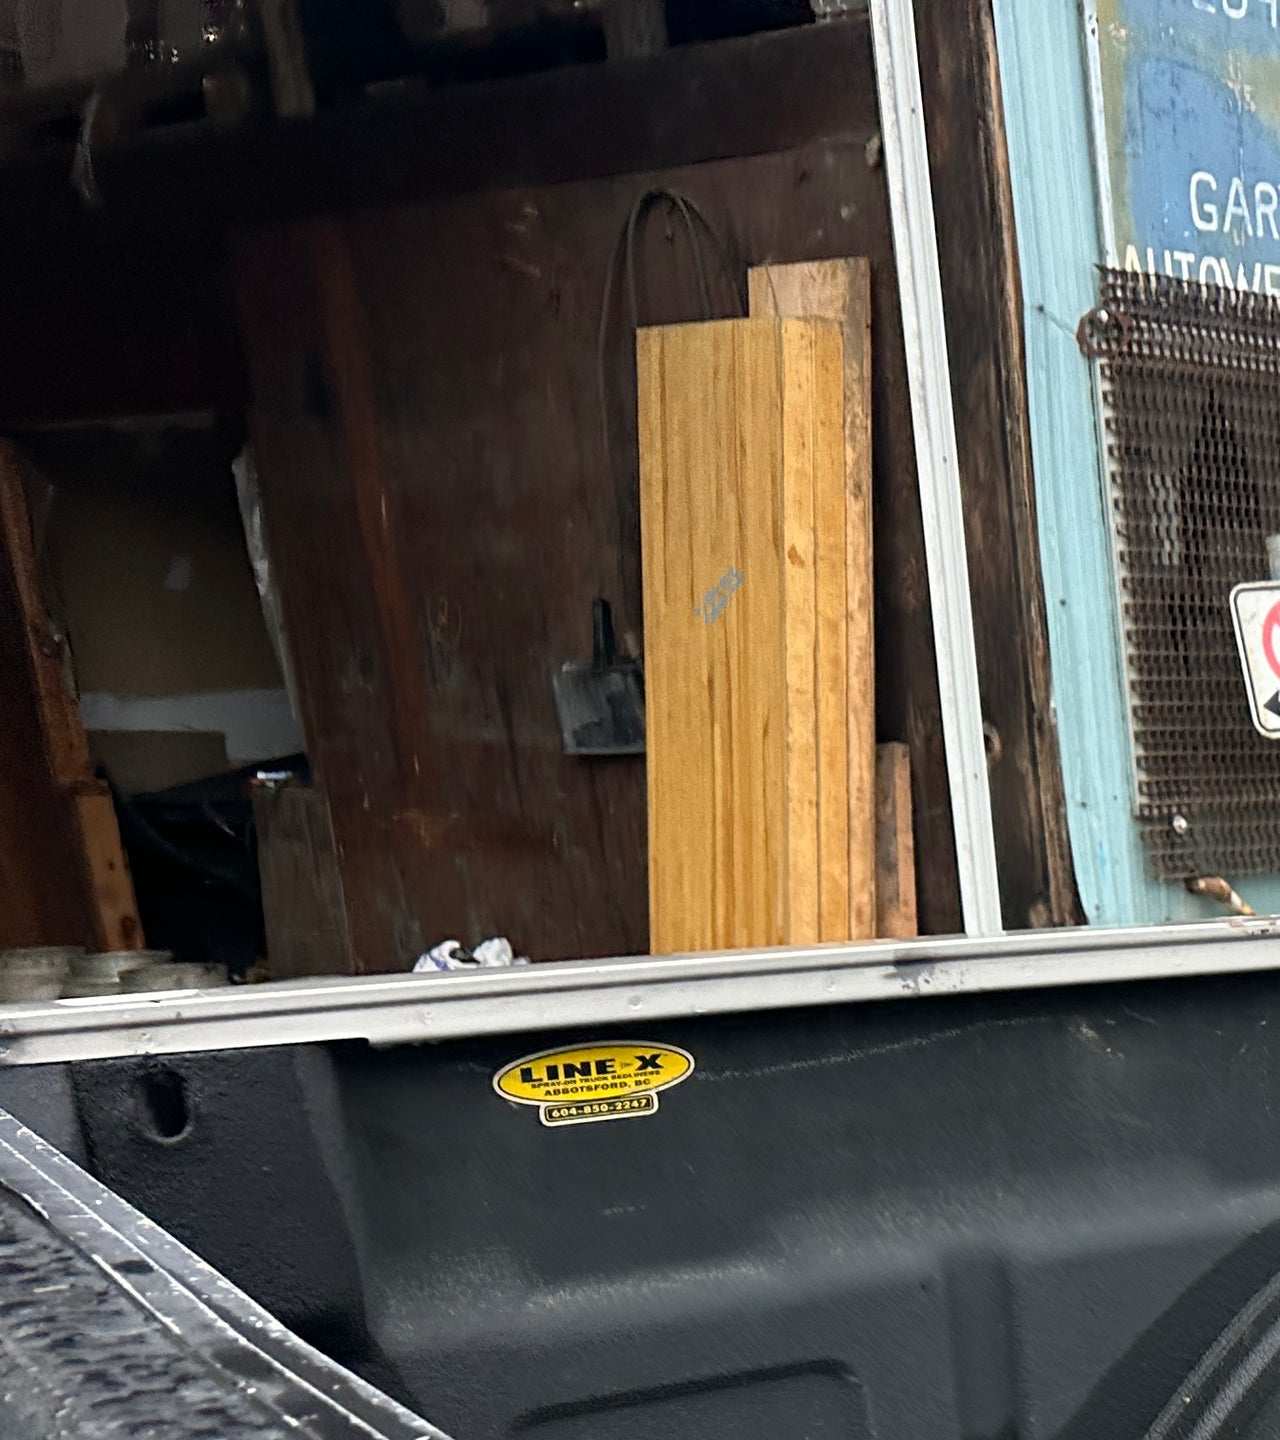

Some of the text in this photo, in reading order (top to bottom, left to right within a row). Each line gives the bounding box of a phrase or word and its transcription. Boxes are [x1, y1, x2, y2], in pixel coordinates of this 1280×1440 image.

[531, 1079, 577, 1089] SPRAY-ON
[579, 1075, 609, 1084] TRUCK
[544, 1078, 650, 1097] ABBOTSFORD, BC
[551, 1099, 648, 1118] 604-850-2247
